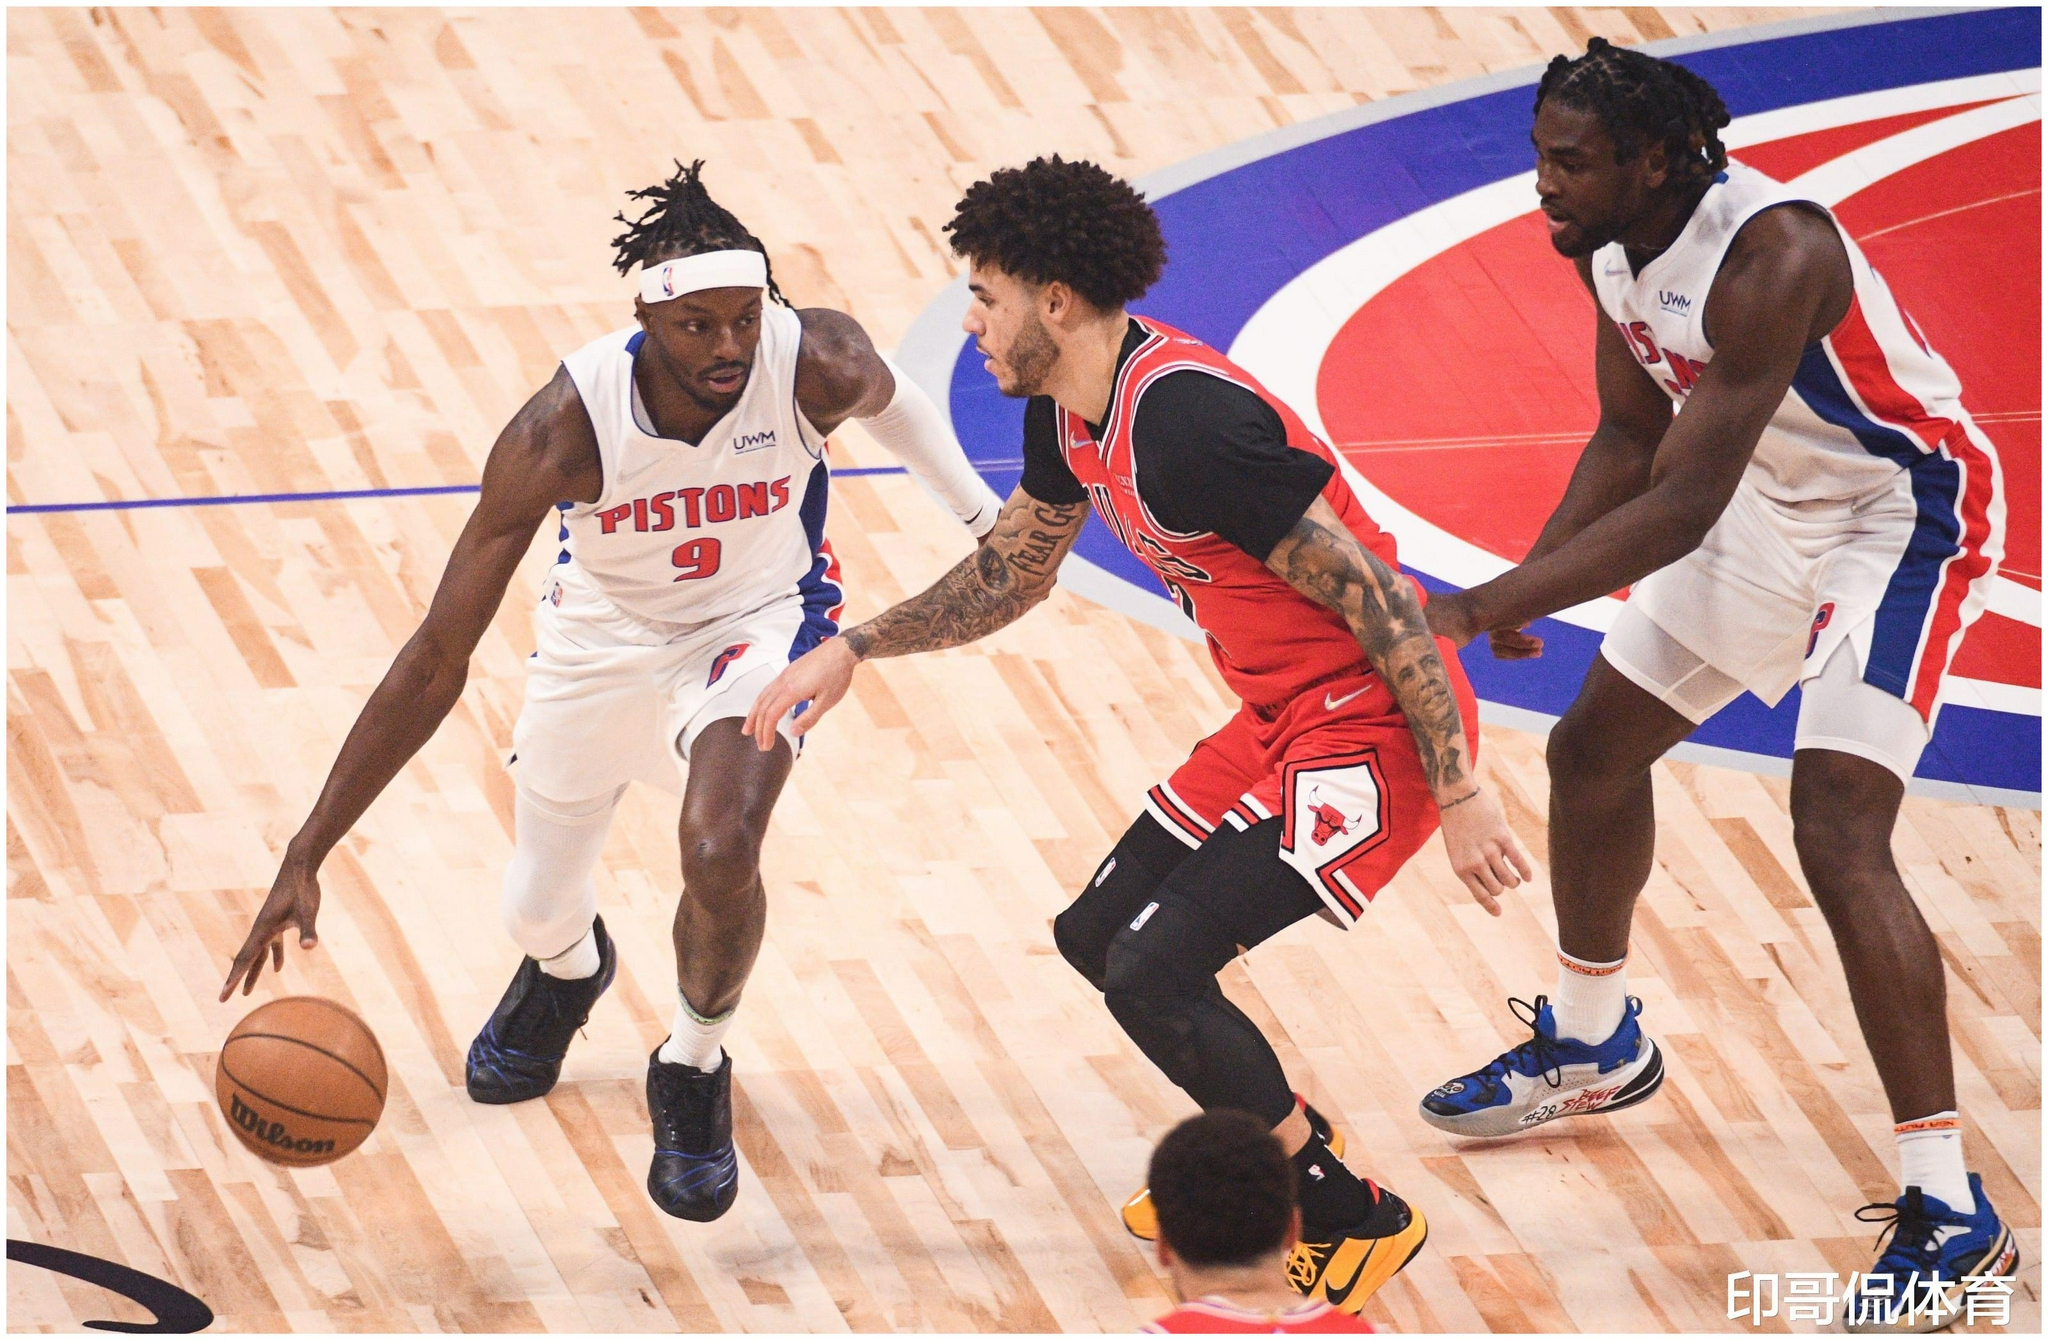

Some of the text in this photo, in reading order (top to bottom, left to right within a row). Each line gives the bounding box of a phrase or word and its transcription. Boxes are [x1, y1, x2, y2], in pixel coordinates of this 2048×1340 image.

[1659, 290, 1691, 310] UWM
[733, 430, 776, 450] UWM
[595, 475, 791, 535] PISTONS
[672, 537, 722, 582] 9
[1006, 530, 1070, 578] FEAR
[1521, 1104, 1557, 1124] #28
[1557, 1098, 1604, 1114] STEW
[230, 1092, 336, 1155] Wilson
